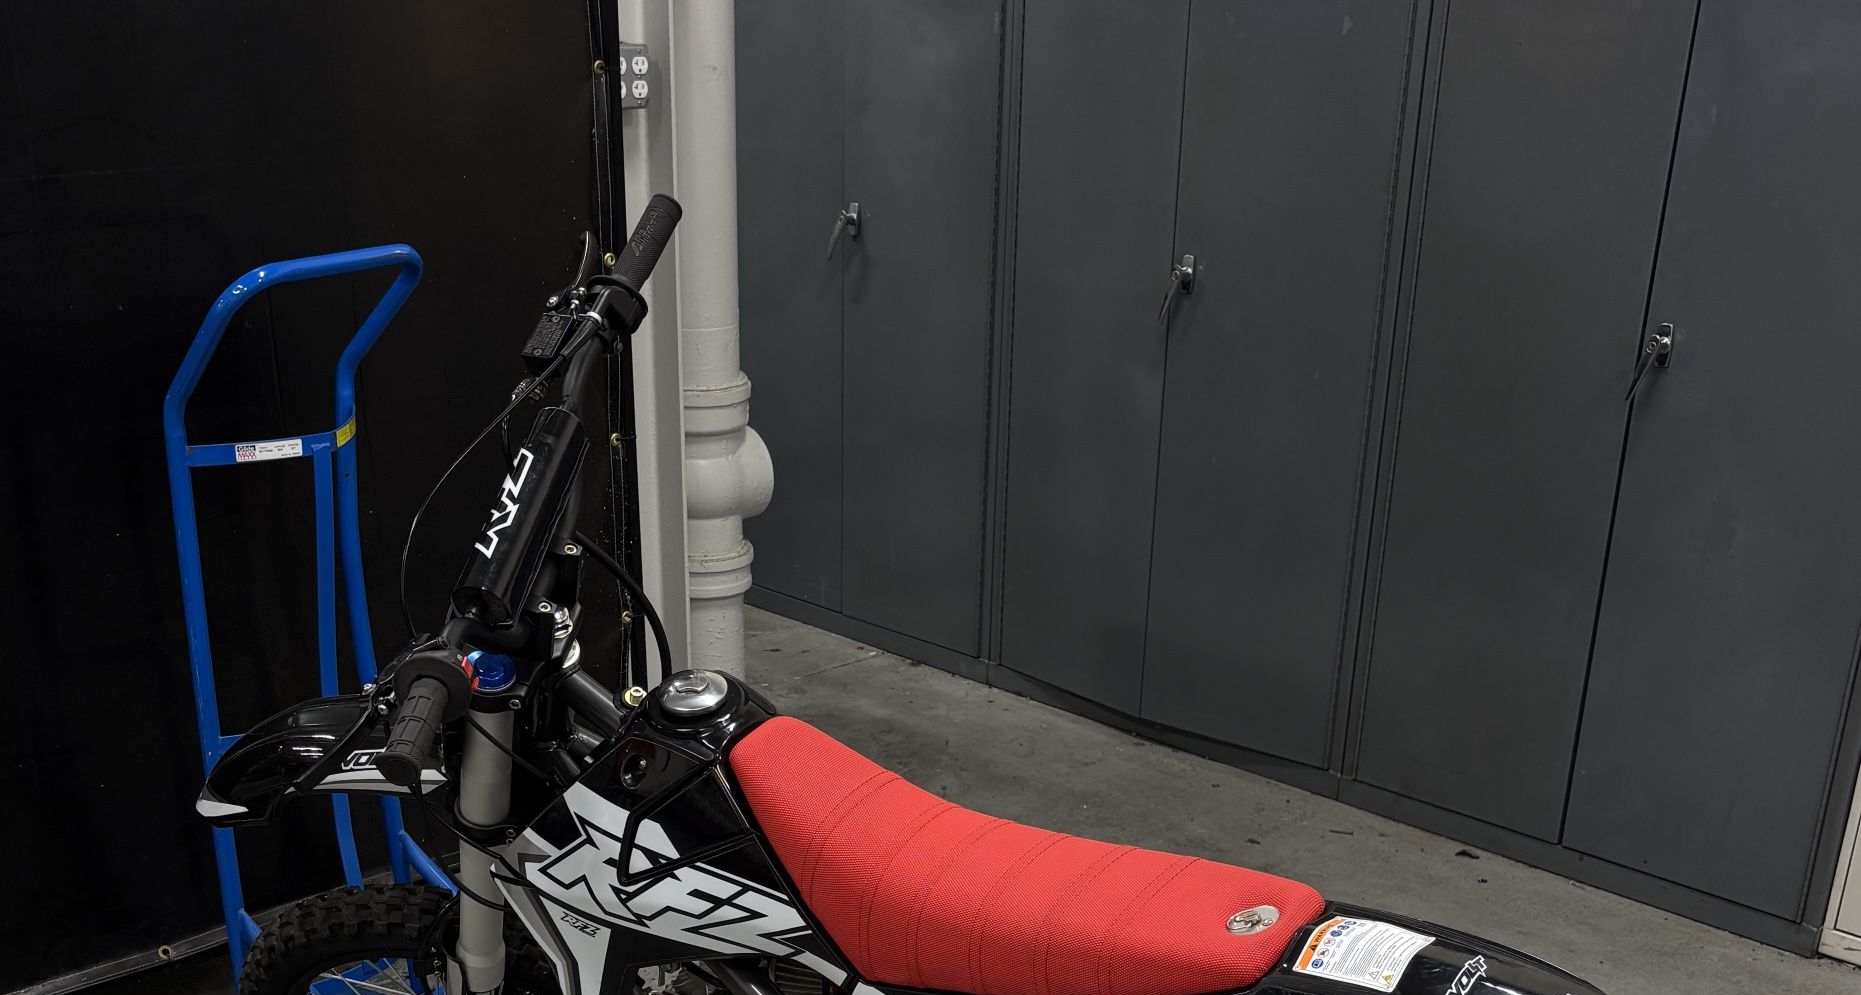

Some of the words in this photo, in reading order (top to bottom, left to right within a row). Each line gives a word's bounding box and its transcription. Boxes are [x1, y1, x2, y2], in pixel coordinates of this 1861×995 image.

[341, 748, 387, 770] VO
[537, 811, 809, 958] RFZ
[561, 911, 600, 938] RFZ
